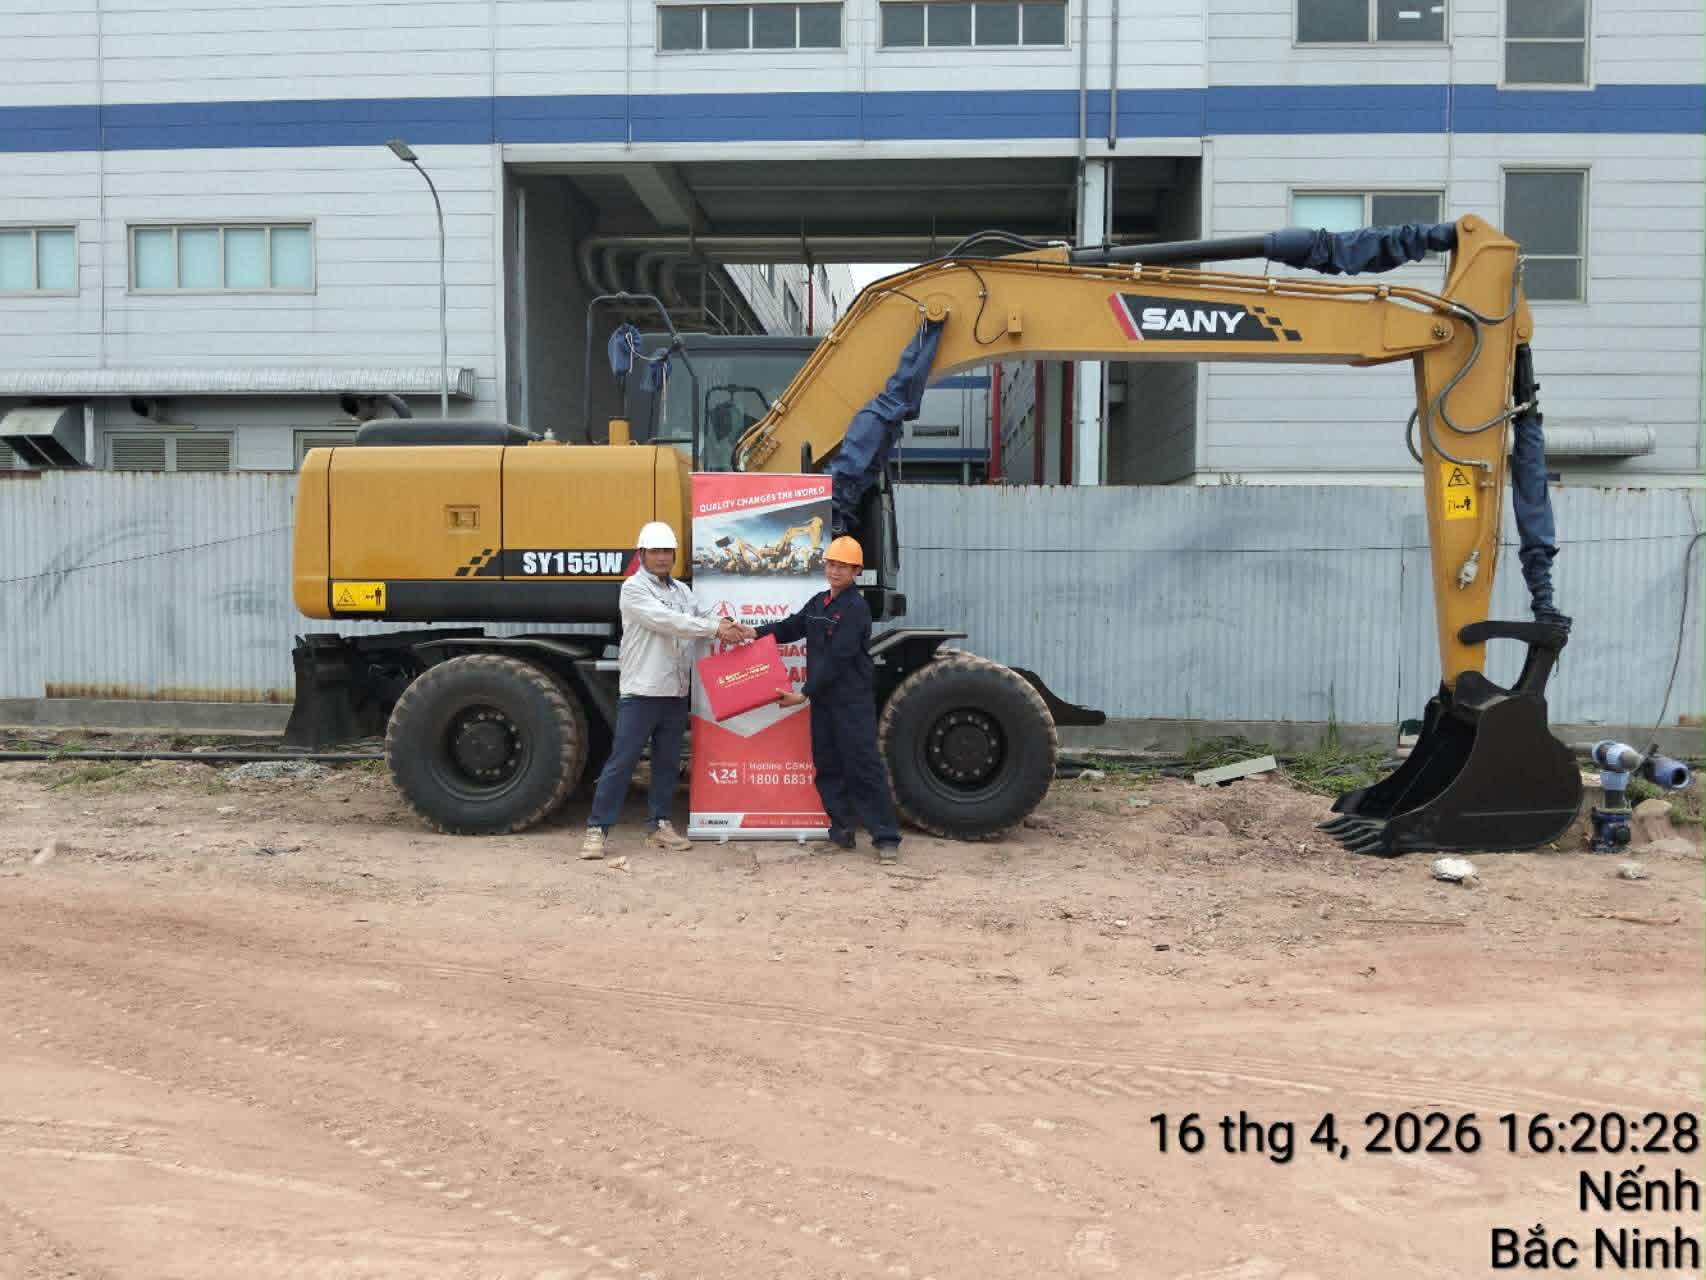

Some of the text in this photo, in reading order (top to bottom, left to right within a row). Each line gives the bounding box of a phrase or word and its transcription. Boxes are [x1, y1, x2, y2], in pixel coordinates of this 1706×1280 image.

[1141, 307, 1246, 334] SANY
[699, 486, 825, 513] QUALITY CHANGES THE WORLD
[522, 551, 623, 575] SY155W
[740, 604, 789, 616] SANY
[720, 768, 737, 779] 24
[750, 774, 779, 785] 1800
